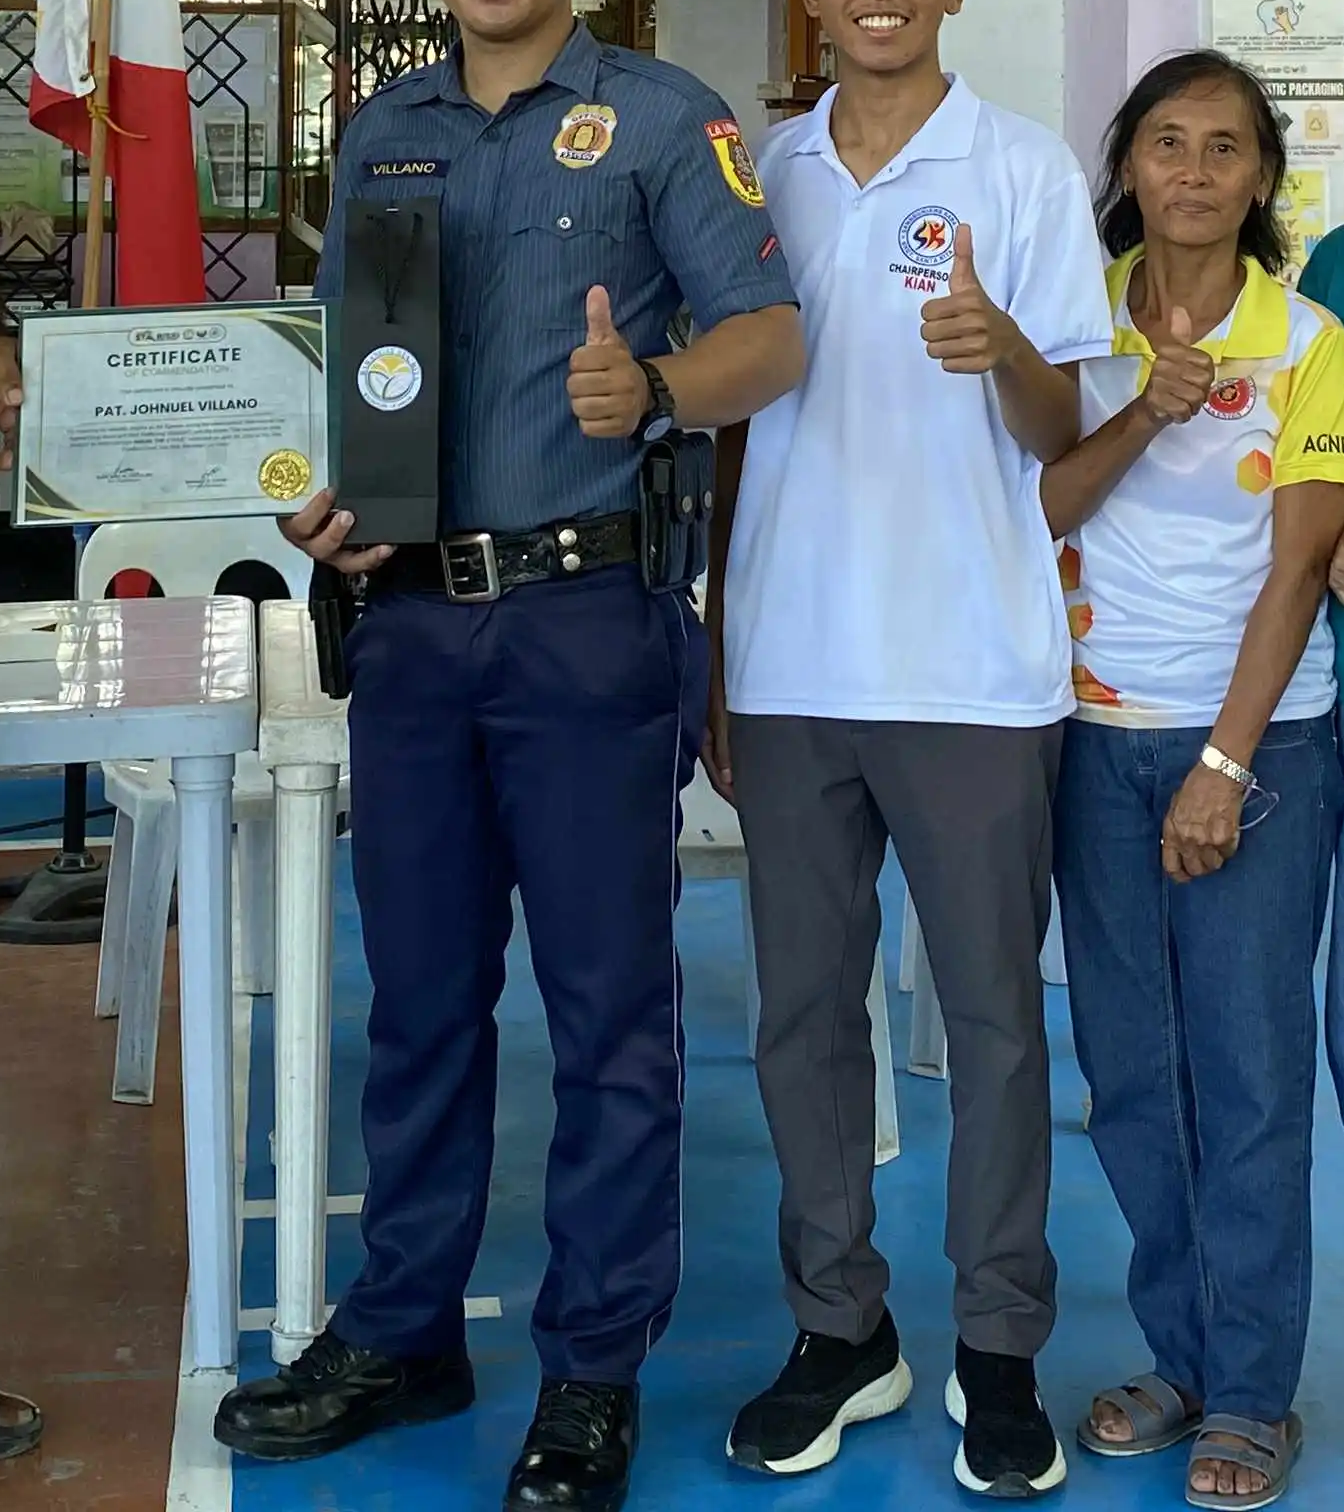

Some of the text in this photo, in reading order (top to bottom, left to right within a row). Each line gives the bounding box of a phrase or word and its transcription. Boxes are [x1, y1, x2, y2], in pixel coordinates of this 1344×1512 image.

[1289, 82, 1344, 97] PACKAGING
[372, 162, 436, 176] VILLANO
[904, 276, 937, 294] KIAN
[107, 347, 242, 368] CERTIFICATE
[95, 398, 258, 417] PAT. JOHNUEL VILLANO
